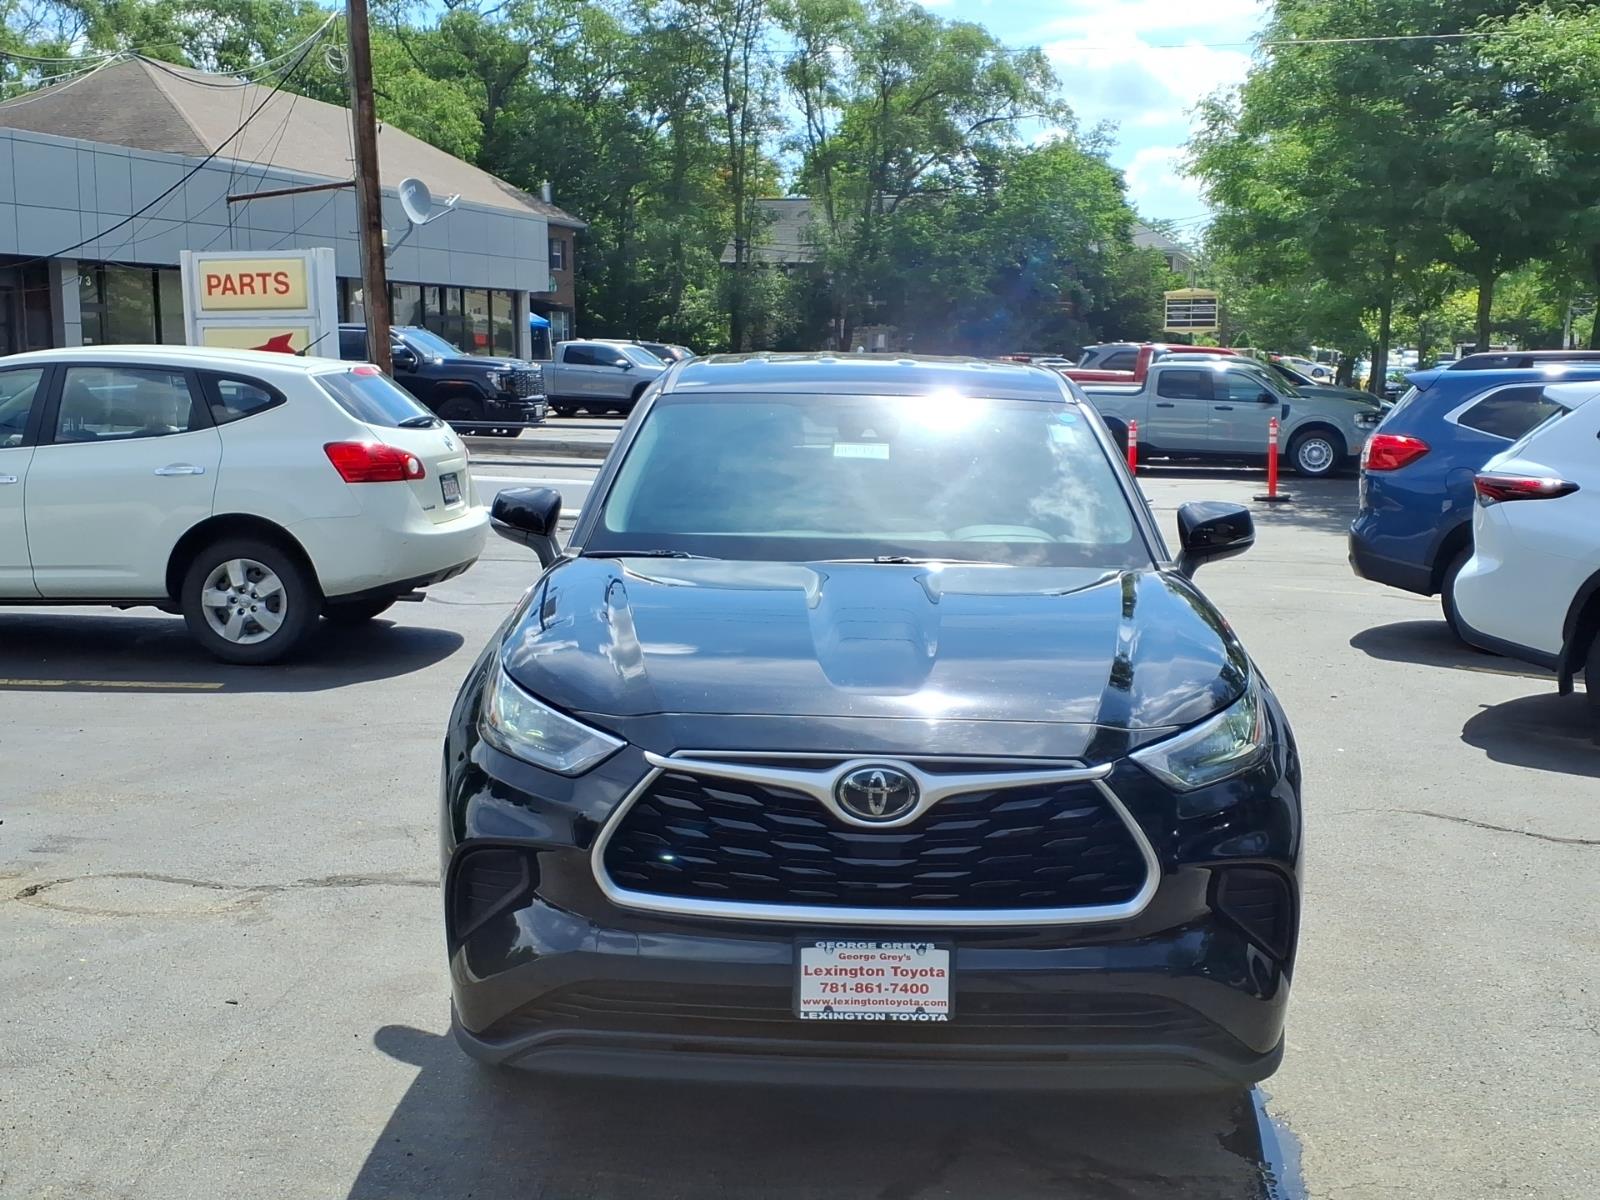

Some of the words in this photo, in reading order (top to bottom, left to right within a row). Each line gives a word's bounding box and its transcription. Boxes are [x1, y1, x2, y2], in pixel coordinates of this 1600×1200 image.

[206, 271, 290, 296] PARTS
[815, 941, 877, 950] GEORGE
[881, 942, 935, 950] GREY'S
[838, 952, 876, 962] George
[879, 953, 912, 962] Grey's
[804, 965, 885, 978] Lexington
[891, 966, 945, 979] Toyota
[820, 982, 929, 994] 781-861-7400
[802, 997, 947, 1007] www.lexingtontoyota.com
[800, 1012, 886, 1021] LEXINGTON
[890, 1013, 948, 1022] TOYOTA
